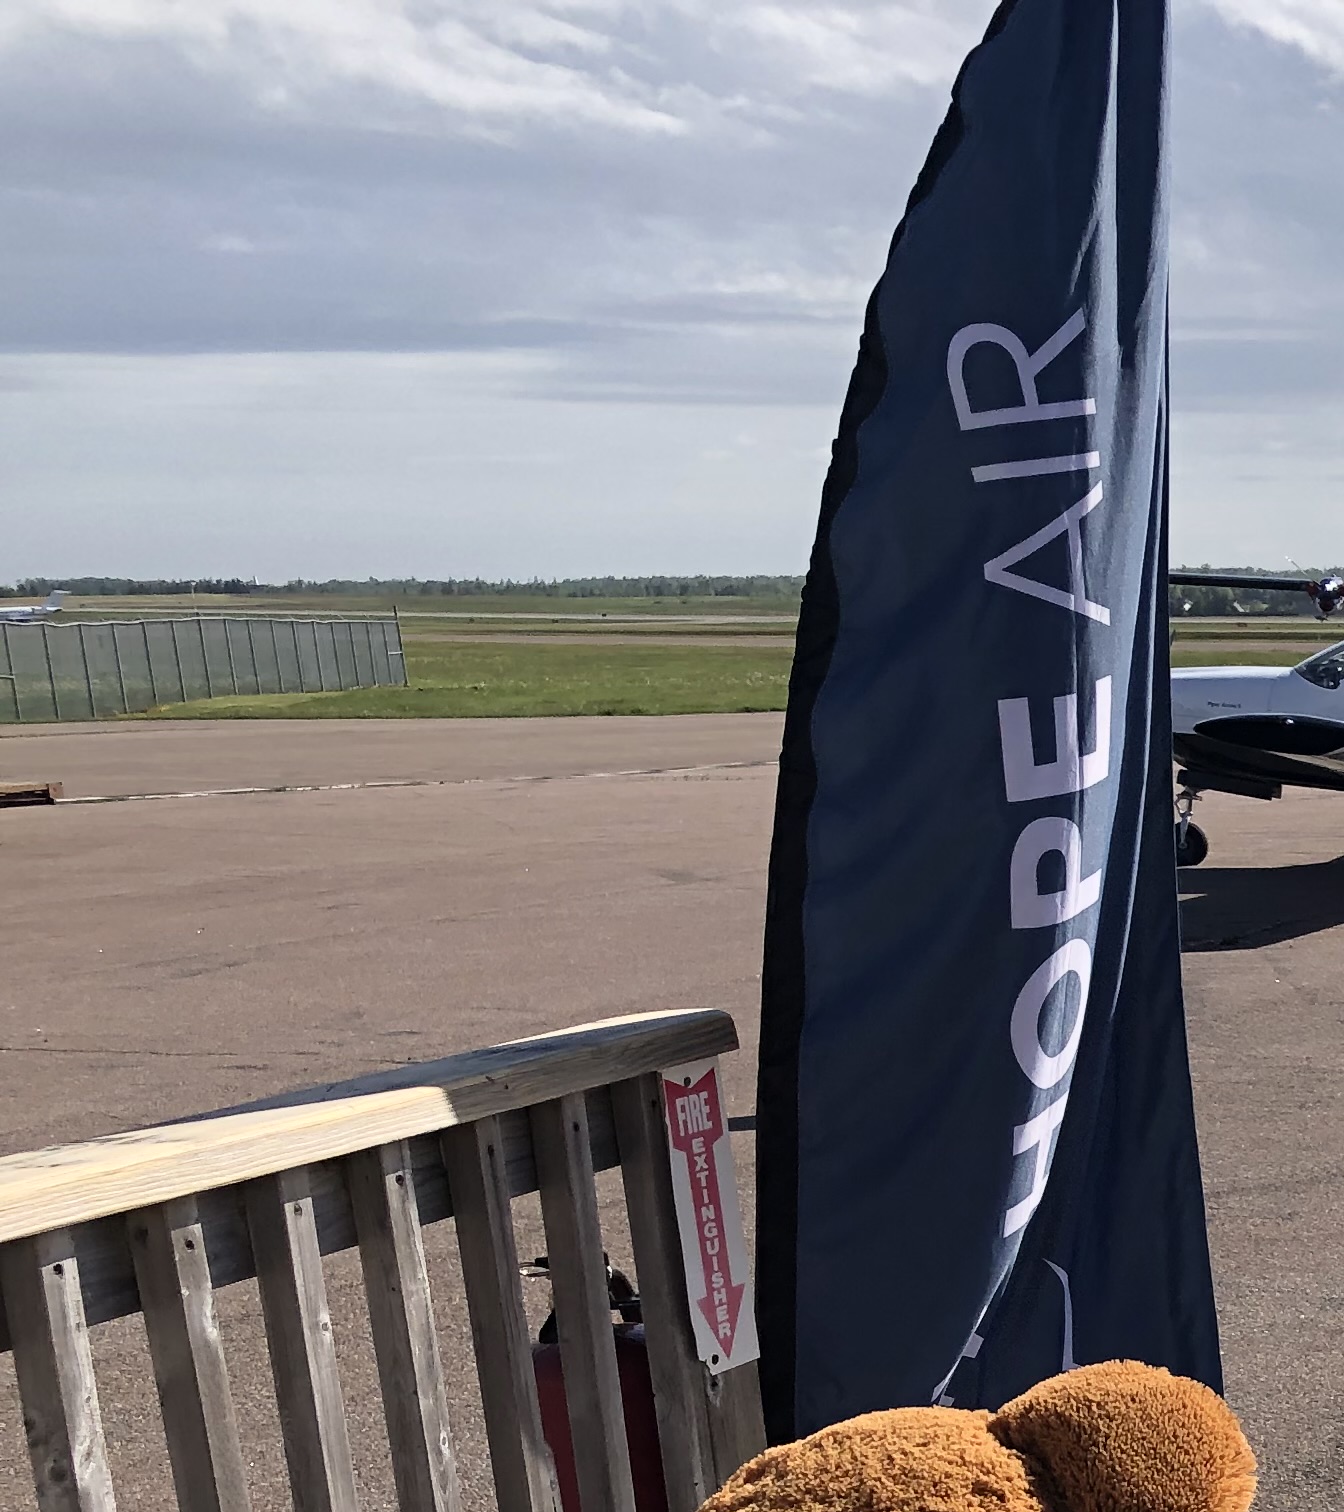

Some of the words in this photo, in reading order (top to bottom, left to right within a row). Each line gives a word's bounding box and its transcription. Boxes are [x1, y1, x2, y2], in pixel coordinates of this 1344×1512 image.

[946, 307, 1111, 626] AIR
[998, 675, 1112, 1239] HOPE
[675, 1091, 713, 1137] FIRE
[691, 1136, 732, 1339] EXTINGUISHER
